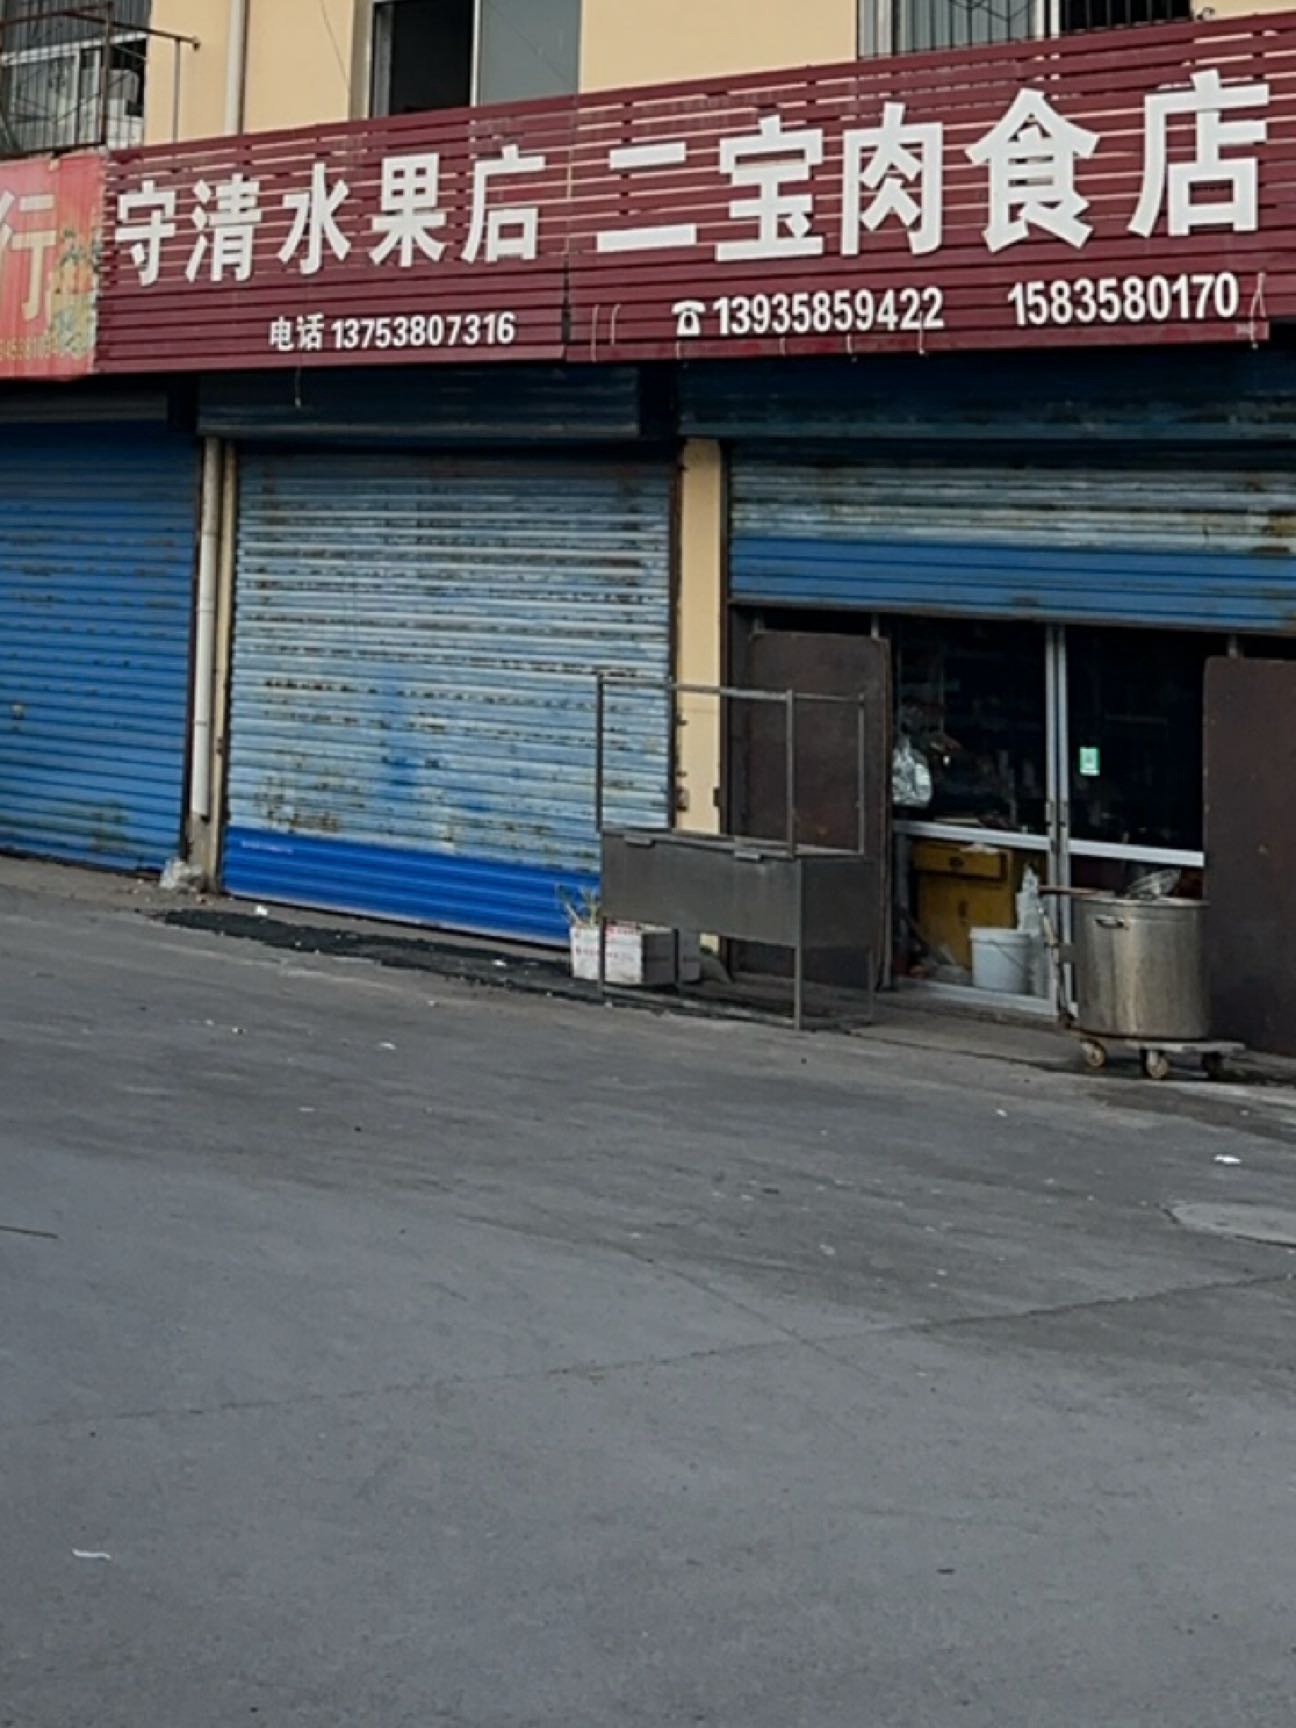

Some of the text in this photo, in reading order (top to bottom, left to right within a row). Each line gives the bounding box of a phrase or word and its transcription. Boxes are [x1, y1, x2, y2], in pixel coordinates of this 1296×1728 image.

[114, 144, 546, 287] 守清水果店
[595, 68, 1271, 262] 二宝肉食店
[268, 310, 517, 352] 电话 13753807316
[712, 272, 1239, 336] 13935859422 1583580170
